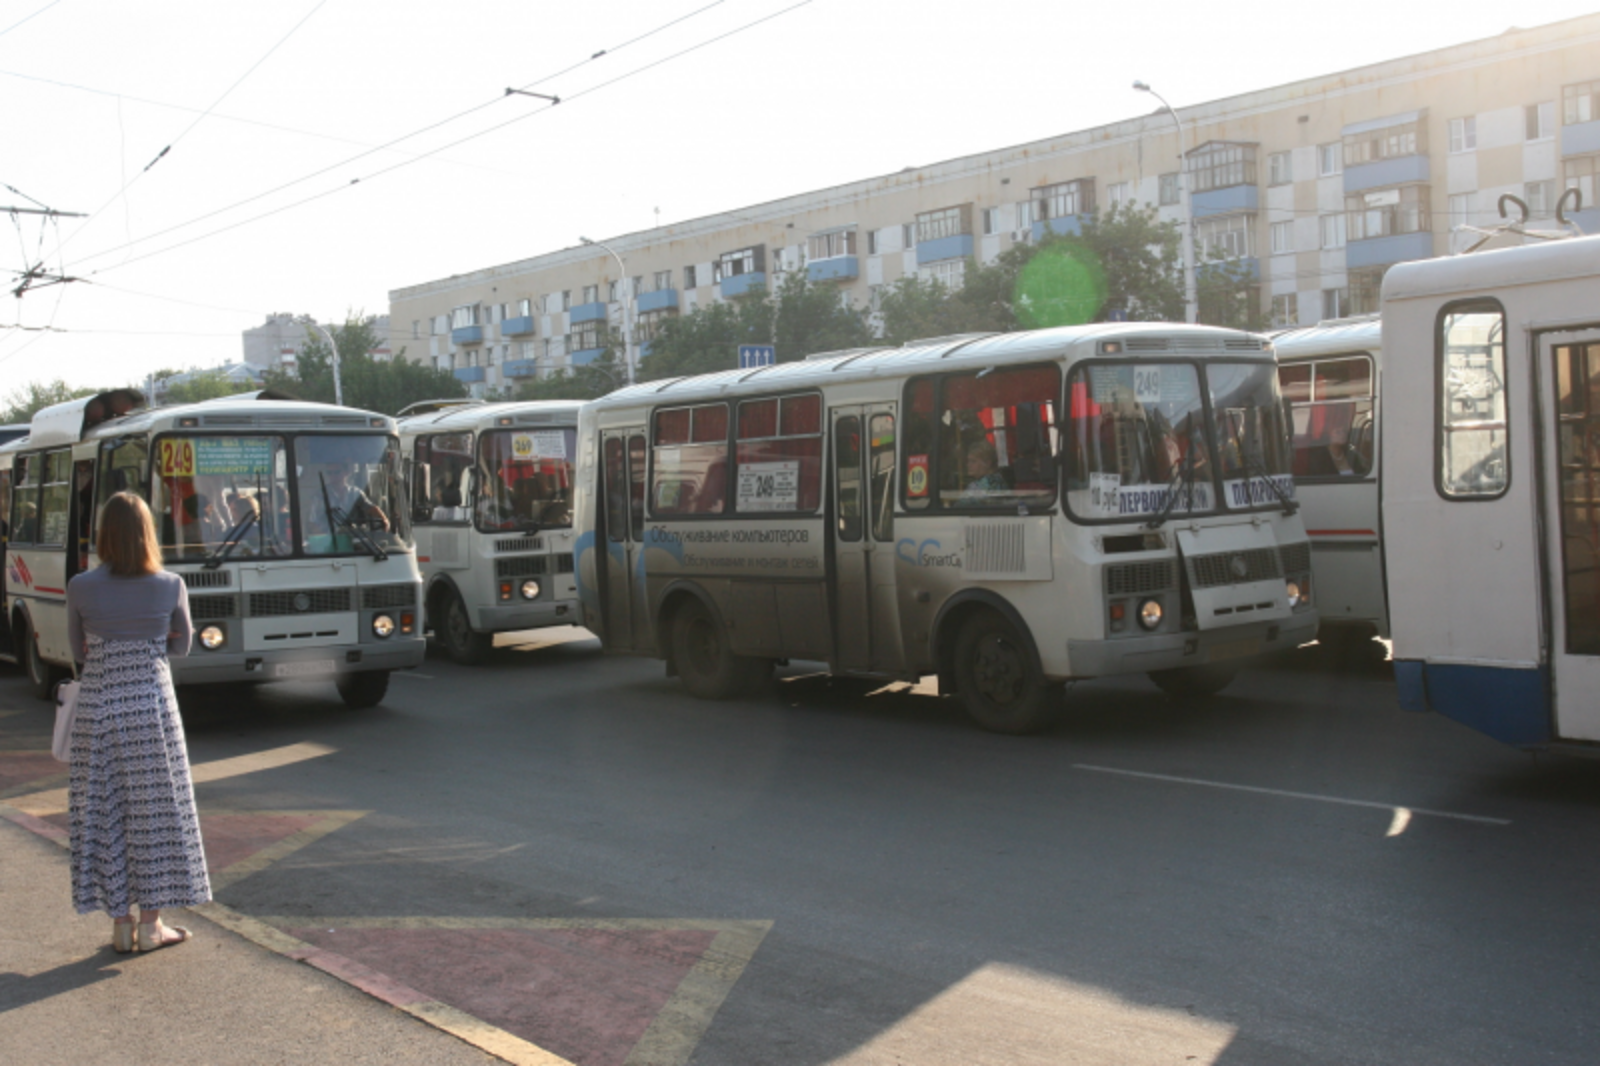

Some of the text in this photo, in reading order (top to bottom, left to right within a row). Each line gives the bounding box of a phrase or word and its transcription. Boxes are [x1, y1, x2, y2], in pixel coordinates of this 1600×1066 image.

[1135, 371, 1159, 395] 249
[163, 441, 193, 473] 249
[756, 475, 774, 498] 249
[911, 470, 924, 484] 10
[651, 525, 809, 548] Обслуживание компьютеров
[683, 553, 745, 570] Обслуживание
[747, 557, 755, 568] и
